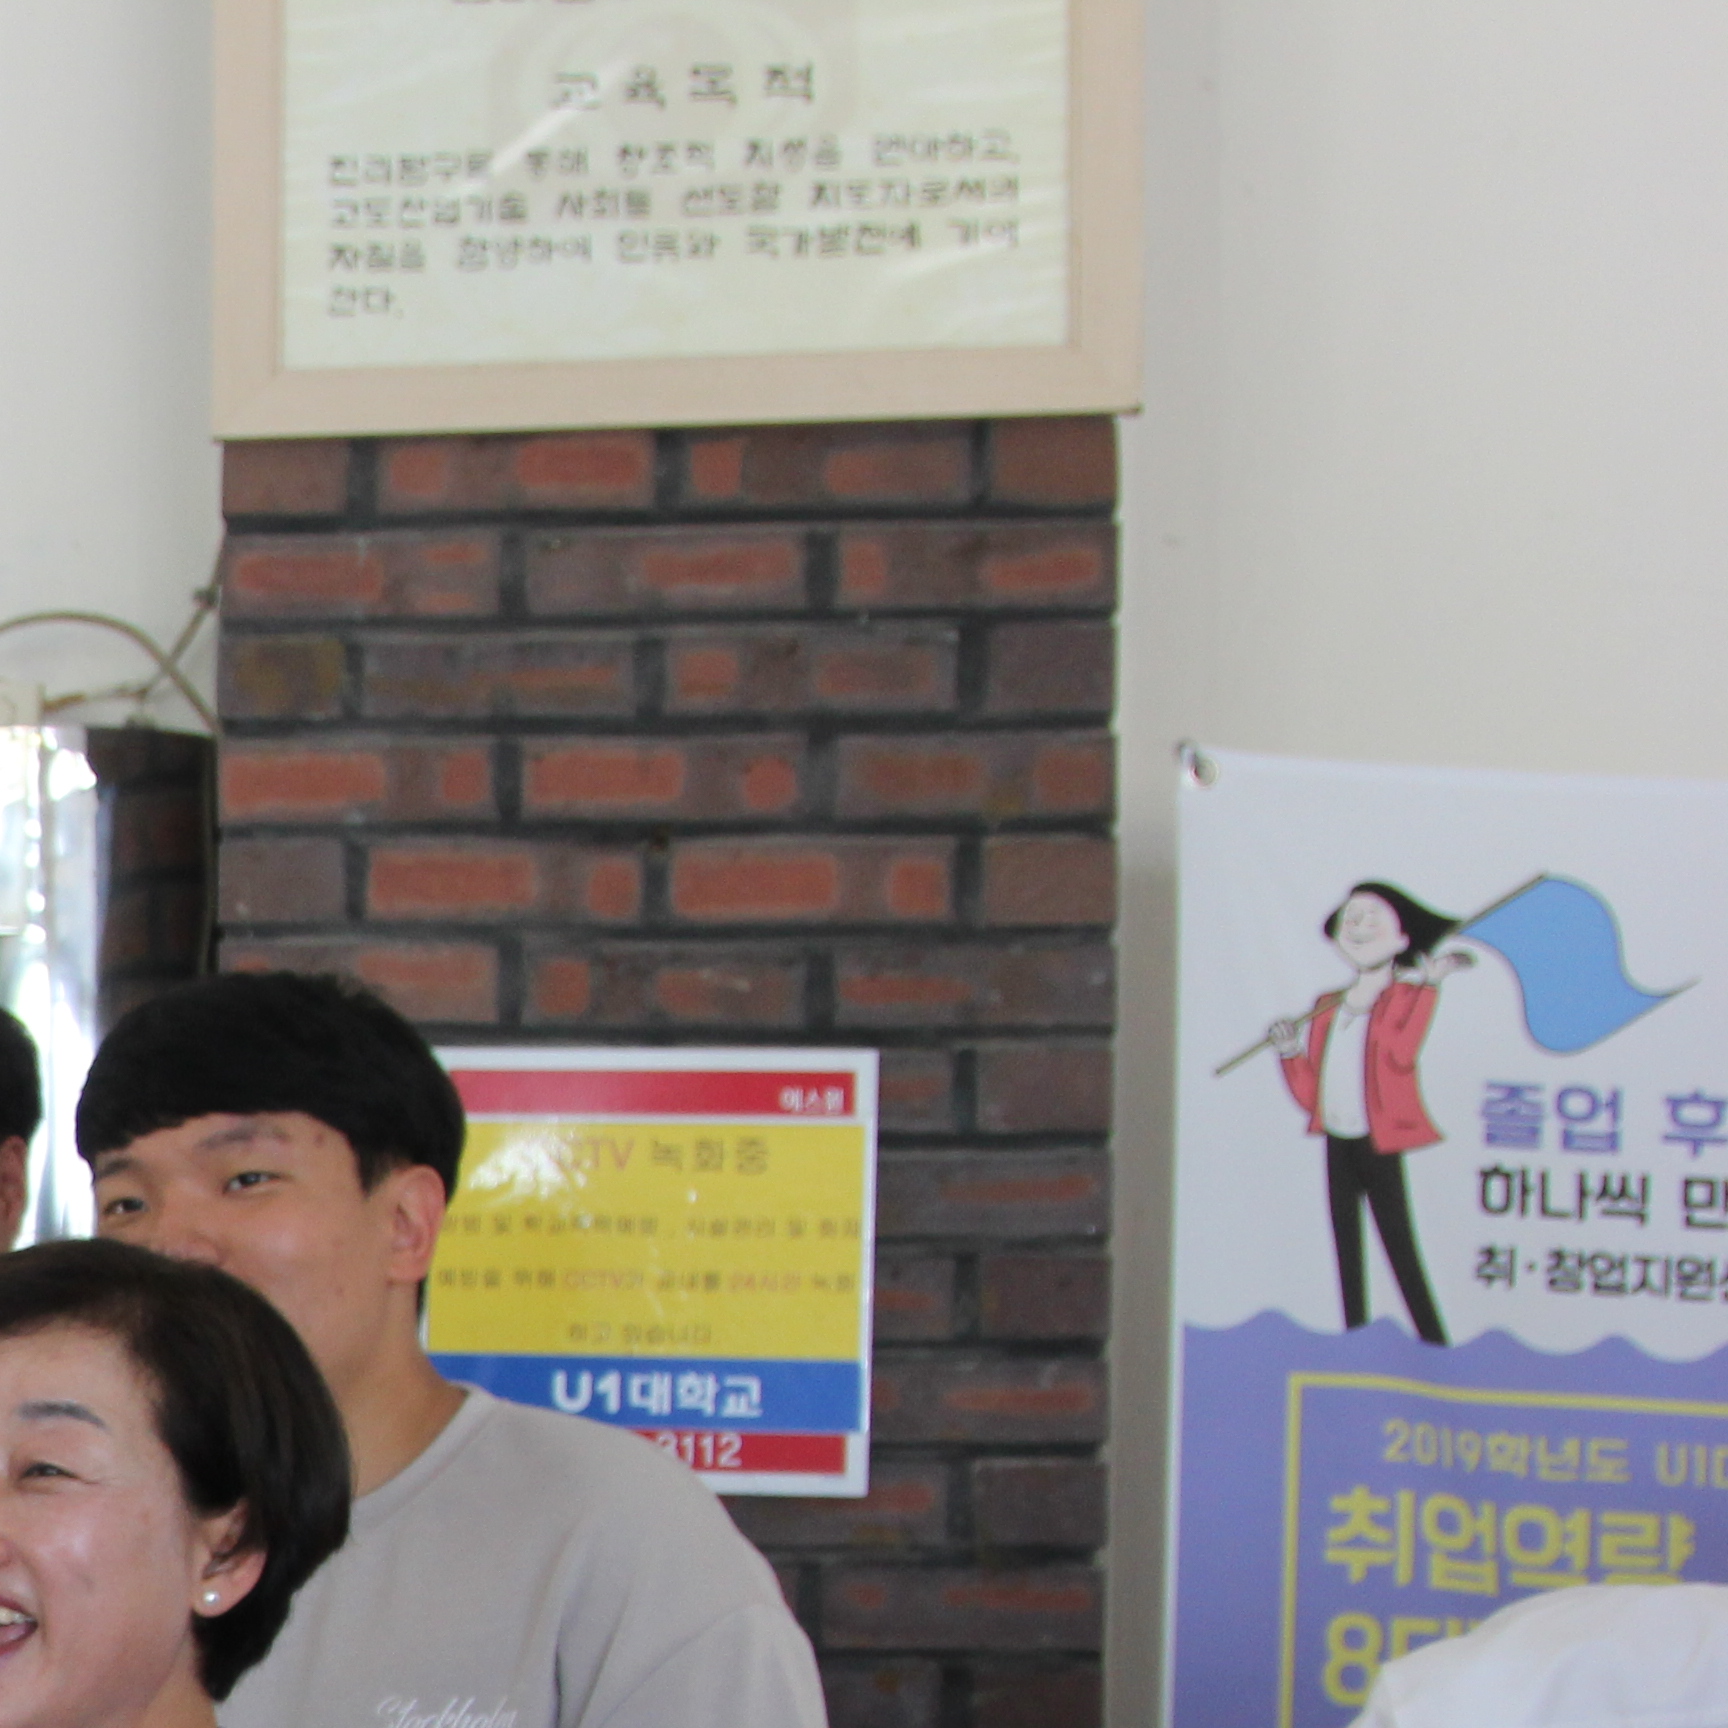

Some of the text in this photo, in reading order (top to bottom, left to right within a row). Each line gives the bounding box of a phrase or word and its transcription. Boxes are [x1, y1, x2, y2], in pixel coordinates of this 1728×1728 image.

[1480, 1080, 1624, 1154] 졸업
[1477, 1164, 1651, 1228] 하나씩
[1475, 1245, 1728, 1302] 취·창업지원
[551, 1369, 763, 1419] U1대학교
[1382, 1417, 1634, 1484] 2019학년도
[1323, 1485, 1696, 1598] 취업역량
